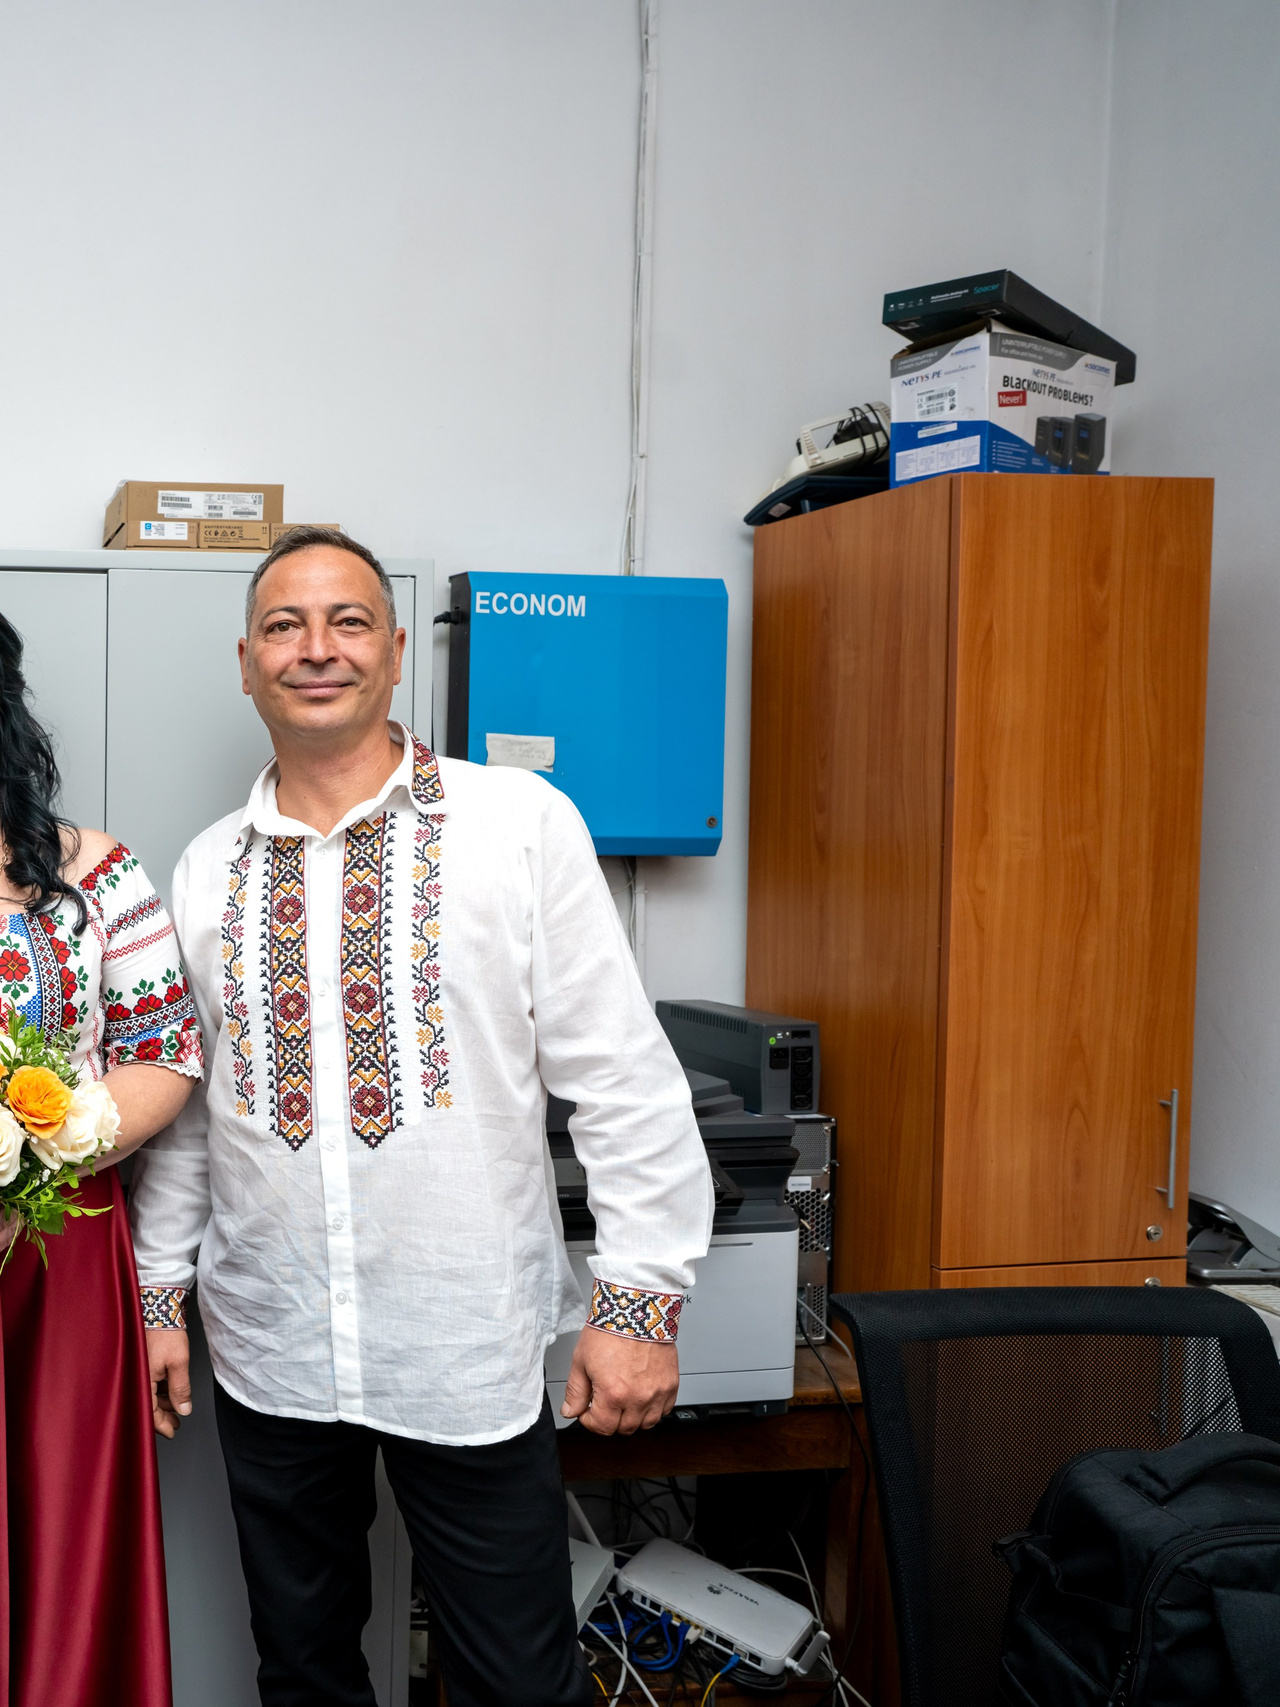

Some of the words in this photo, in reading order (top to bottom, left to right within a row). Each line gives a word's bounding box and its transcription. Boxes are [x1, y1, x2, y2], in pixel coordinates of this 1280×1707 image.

[973, 284, 1000, 294] Spacer
[931, 370, 942, 380] PE
[1049, 372, 1057, 382] PE
[999, 394, 1024, 405] Never!
[475, 591, 586, 617] ECONOM
